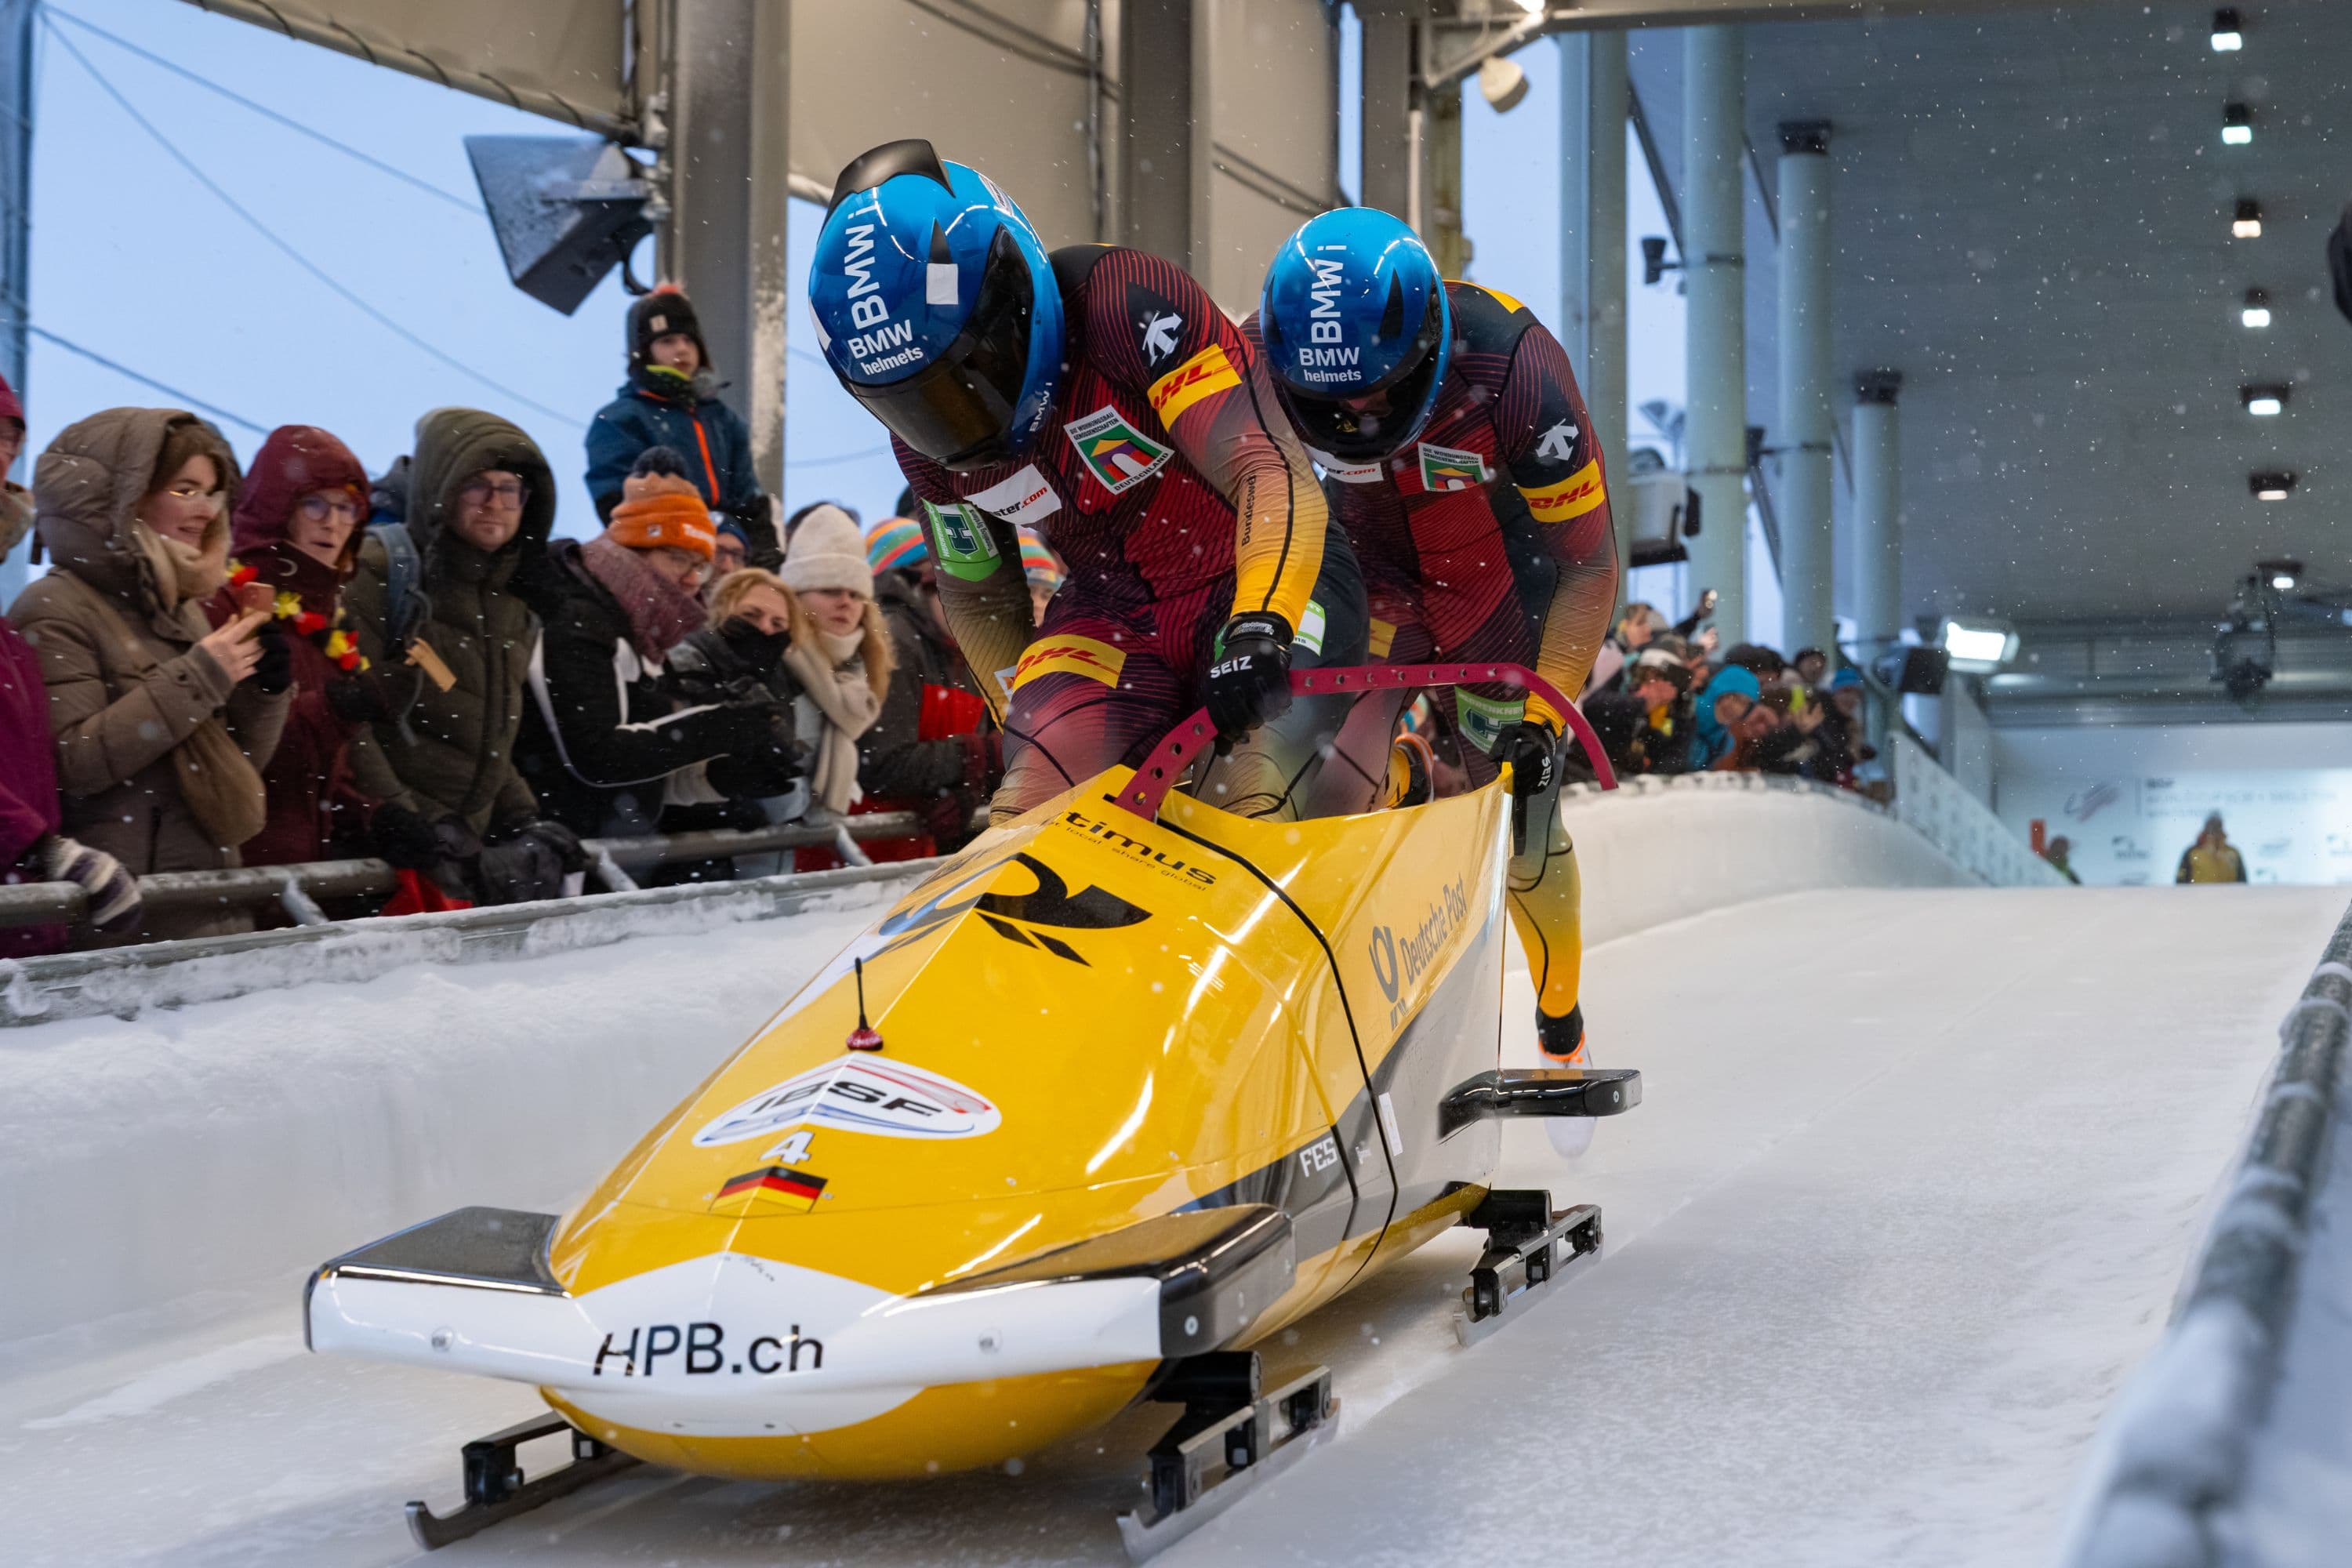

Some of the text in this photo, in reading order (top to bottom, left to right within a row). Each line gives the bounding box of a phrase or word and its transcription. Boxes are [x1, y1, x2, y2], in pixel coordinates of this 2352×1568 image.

[844, 204, 890, 330] BMW i
[1311, 260, 1344, 343] BMW
[848, 319, 913, 359] BMW
[1298, 347, 1360, 366] BMW
[861, 347, 924, 376] helmets
[1304, 369, 1362, 383] helmets
[1029, 390, 1050, 432] BMW
[1114, 452, 1168, 491] DEUTSCHLAND
[1528, 480, 1595, 510] DHL
[1210, 655, 1253, 678] SEIZ
[1537, 756, 1553, 787] SEIZ
[1399, 872, 1468, 985] Deutsche Post
[751, 1080, 943, 1116] IBSF
[759, 1130, 816, 1165] 4
[1299, 1136, 1338, 1178] FES
[593, 1322, 824, 1377] HPB.ch
